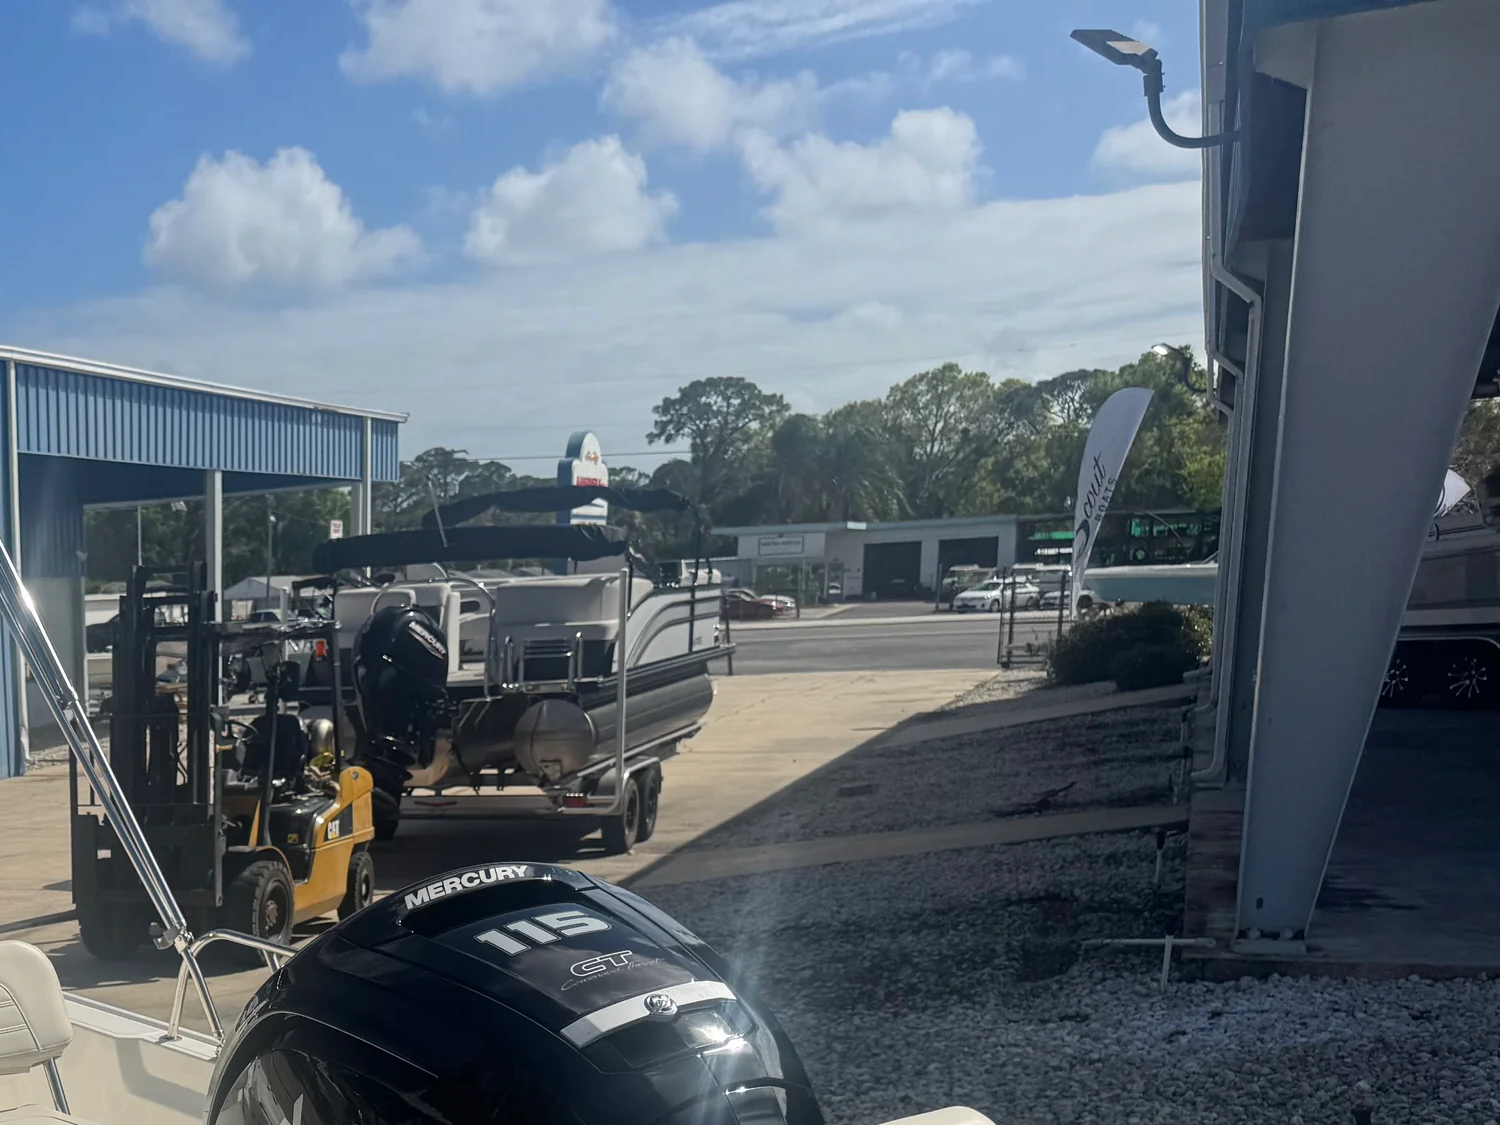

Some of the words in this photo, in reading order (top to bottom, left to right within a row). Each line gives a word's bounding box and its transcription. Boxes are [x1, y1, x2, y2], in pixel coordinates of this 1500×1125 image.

[1094, 476, 1117, 522] BOATS
[408, 620, 448, 655] MERCURY
[327, 819, 340, 840] CAT
[403, 864, 529, 911] MERCURY
[473, 909, 613, 957] 115
[569, 949, 633, 977] GT
